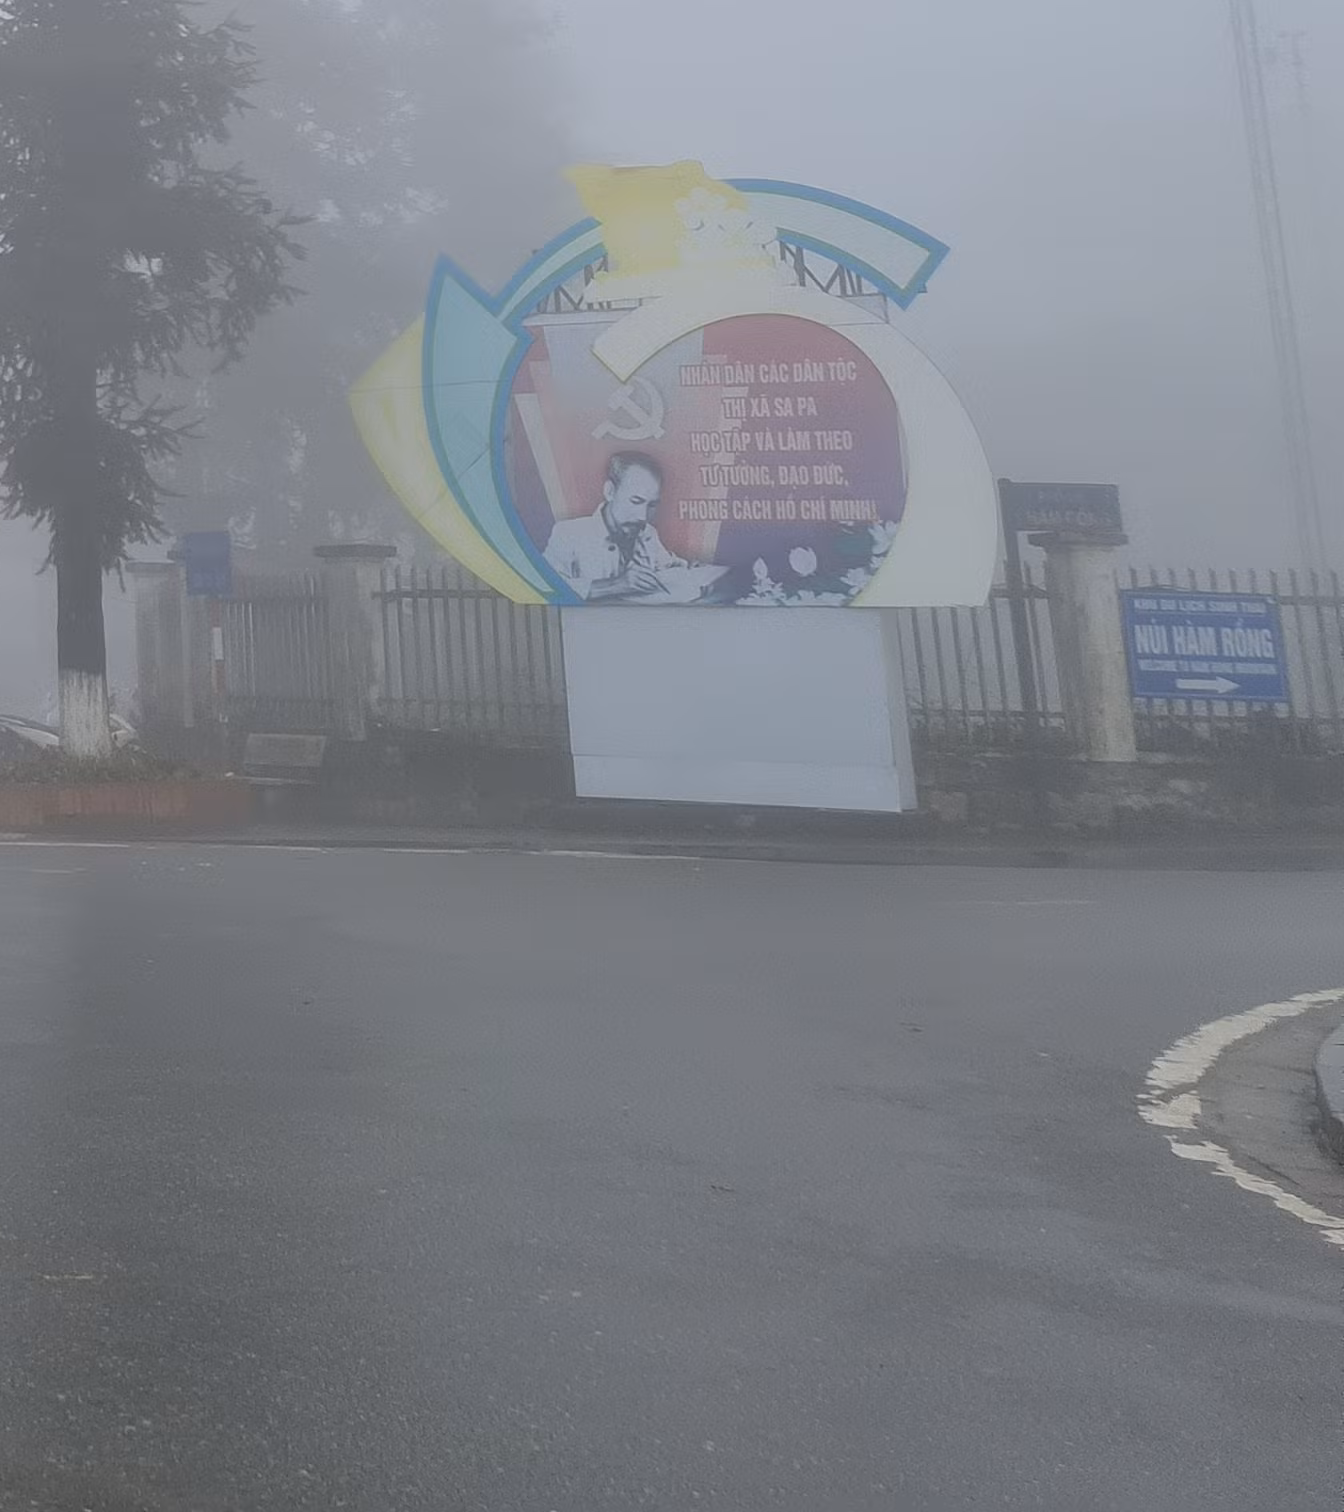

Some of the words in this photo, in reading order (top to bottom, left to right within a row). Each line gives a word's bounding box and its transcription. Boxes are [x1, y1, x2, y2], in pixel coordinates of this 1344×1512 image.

[680, 360, 720, 386] NHÂN
[725, 360, 755, 386] DÂN
[760, 358, 789, 384] CÁC
[794, 358, 824, 384] DÂN
[829, 357, 858, 386] TỘC
[723, 397, 746, 423] THỊ
[750, 394, 771, 418] XÃ
[774, 397, 795, 418] SA
[798, 396, 818, 417] PA
[691, 431, 722, 457] HỌC
[724, 427, 751, 456] TẬP
[755, 427, 776, 452] VÀ
[778, 426, 811, 452] LÀM
[814, 430, 853, 451] THEO
[779, 464, 809, 490] ĐẠO
[679, 499, 728, 520] PHONG
[732, 496, 771, 520] CÁCH
[800, 496, 828, 520] CHÍ
[1135, 619, 1169, 654] NÚI
[1173, 620, 1217, 656] HÀM
[1220, 618, 1275, 659] RỒNG
